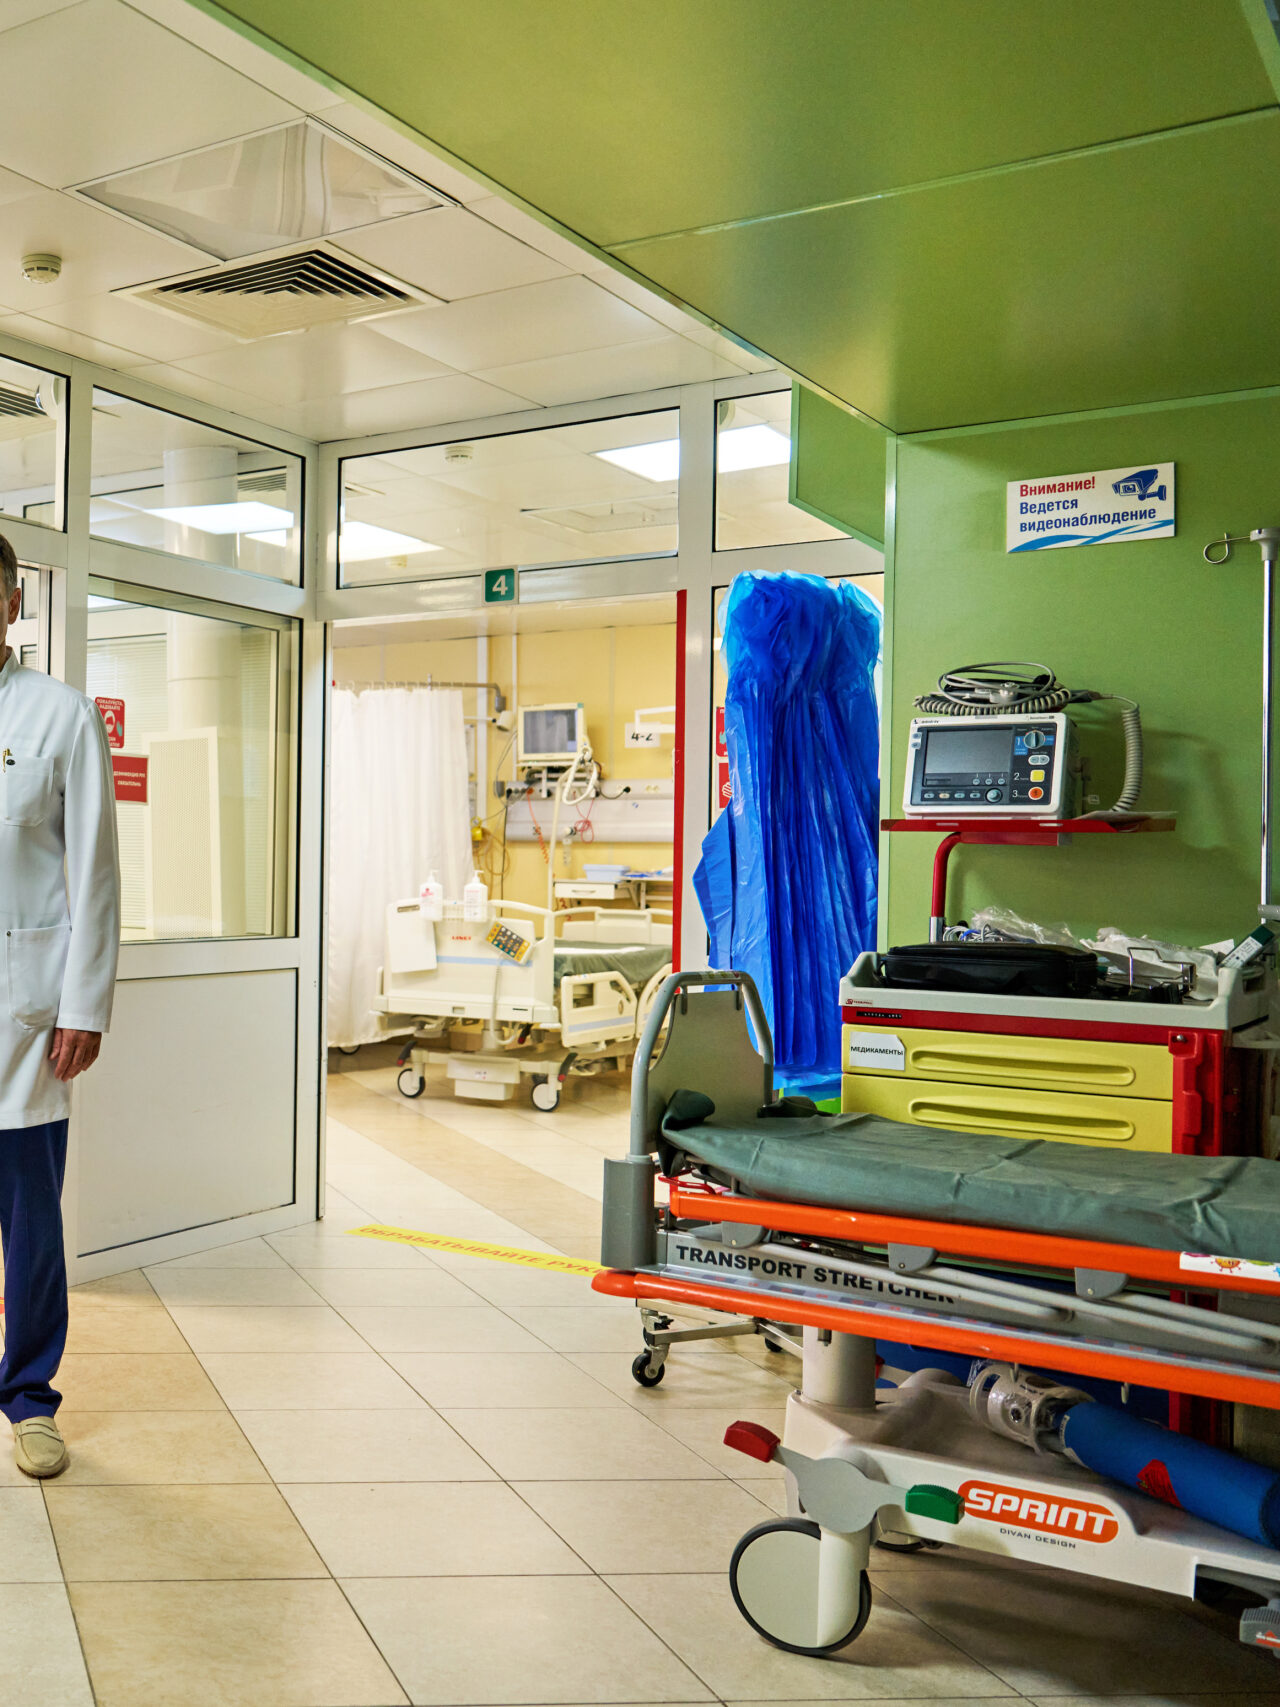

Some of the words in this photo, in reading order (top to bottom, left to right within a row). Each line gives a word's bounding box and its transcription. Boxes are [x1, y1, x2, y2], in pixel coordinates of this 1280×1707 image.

[1019, 475, 1095, 497] Внимание!
[1019, 498, 1078, 515] Ведется
[1019, 508, 1156, 533] видеонаблюдение
[492, 575, 508, 596] 4
[1014, 772, 1020, 780] 2
[1012, 790, 1018, 798] 3
[850, 1046, 904, 1056] МЕДИКАМЕНТЫ
[359, 1226, 546, 1264] ОБРАБАТЫВАЙТЕ
[676, 1245, 807, 1279] TRANSPORT
[965, 1487, 1118, 1535] SPRINT
[999, 1527, 1031, 1540] DIVAN
[1035, 1535, 1076, 1549] DESIGN
